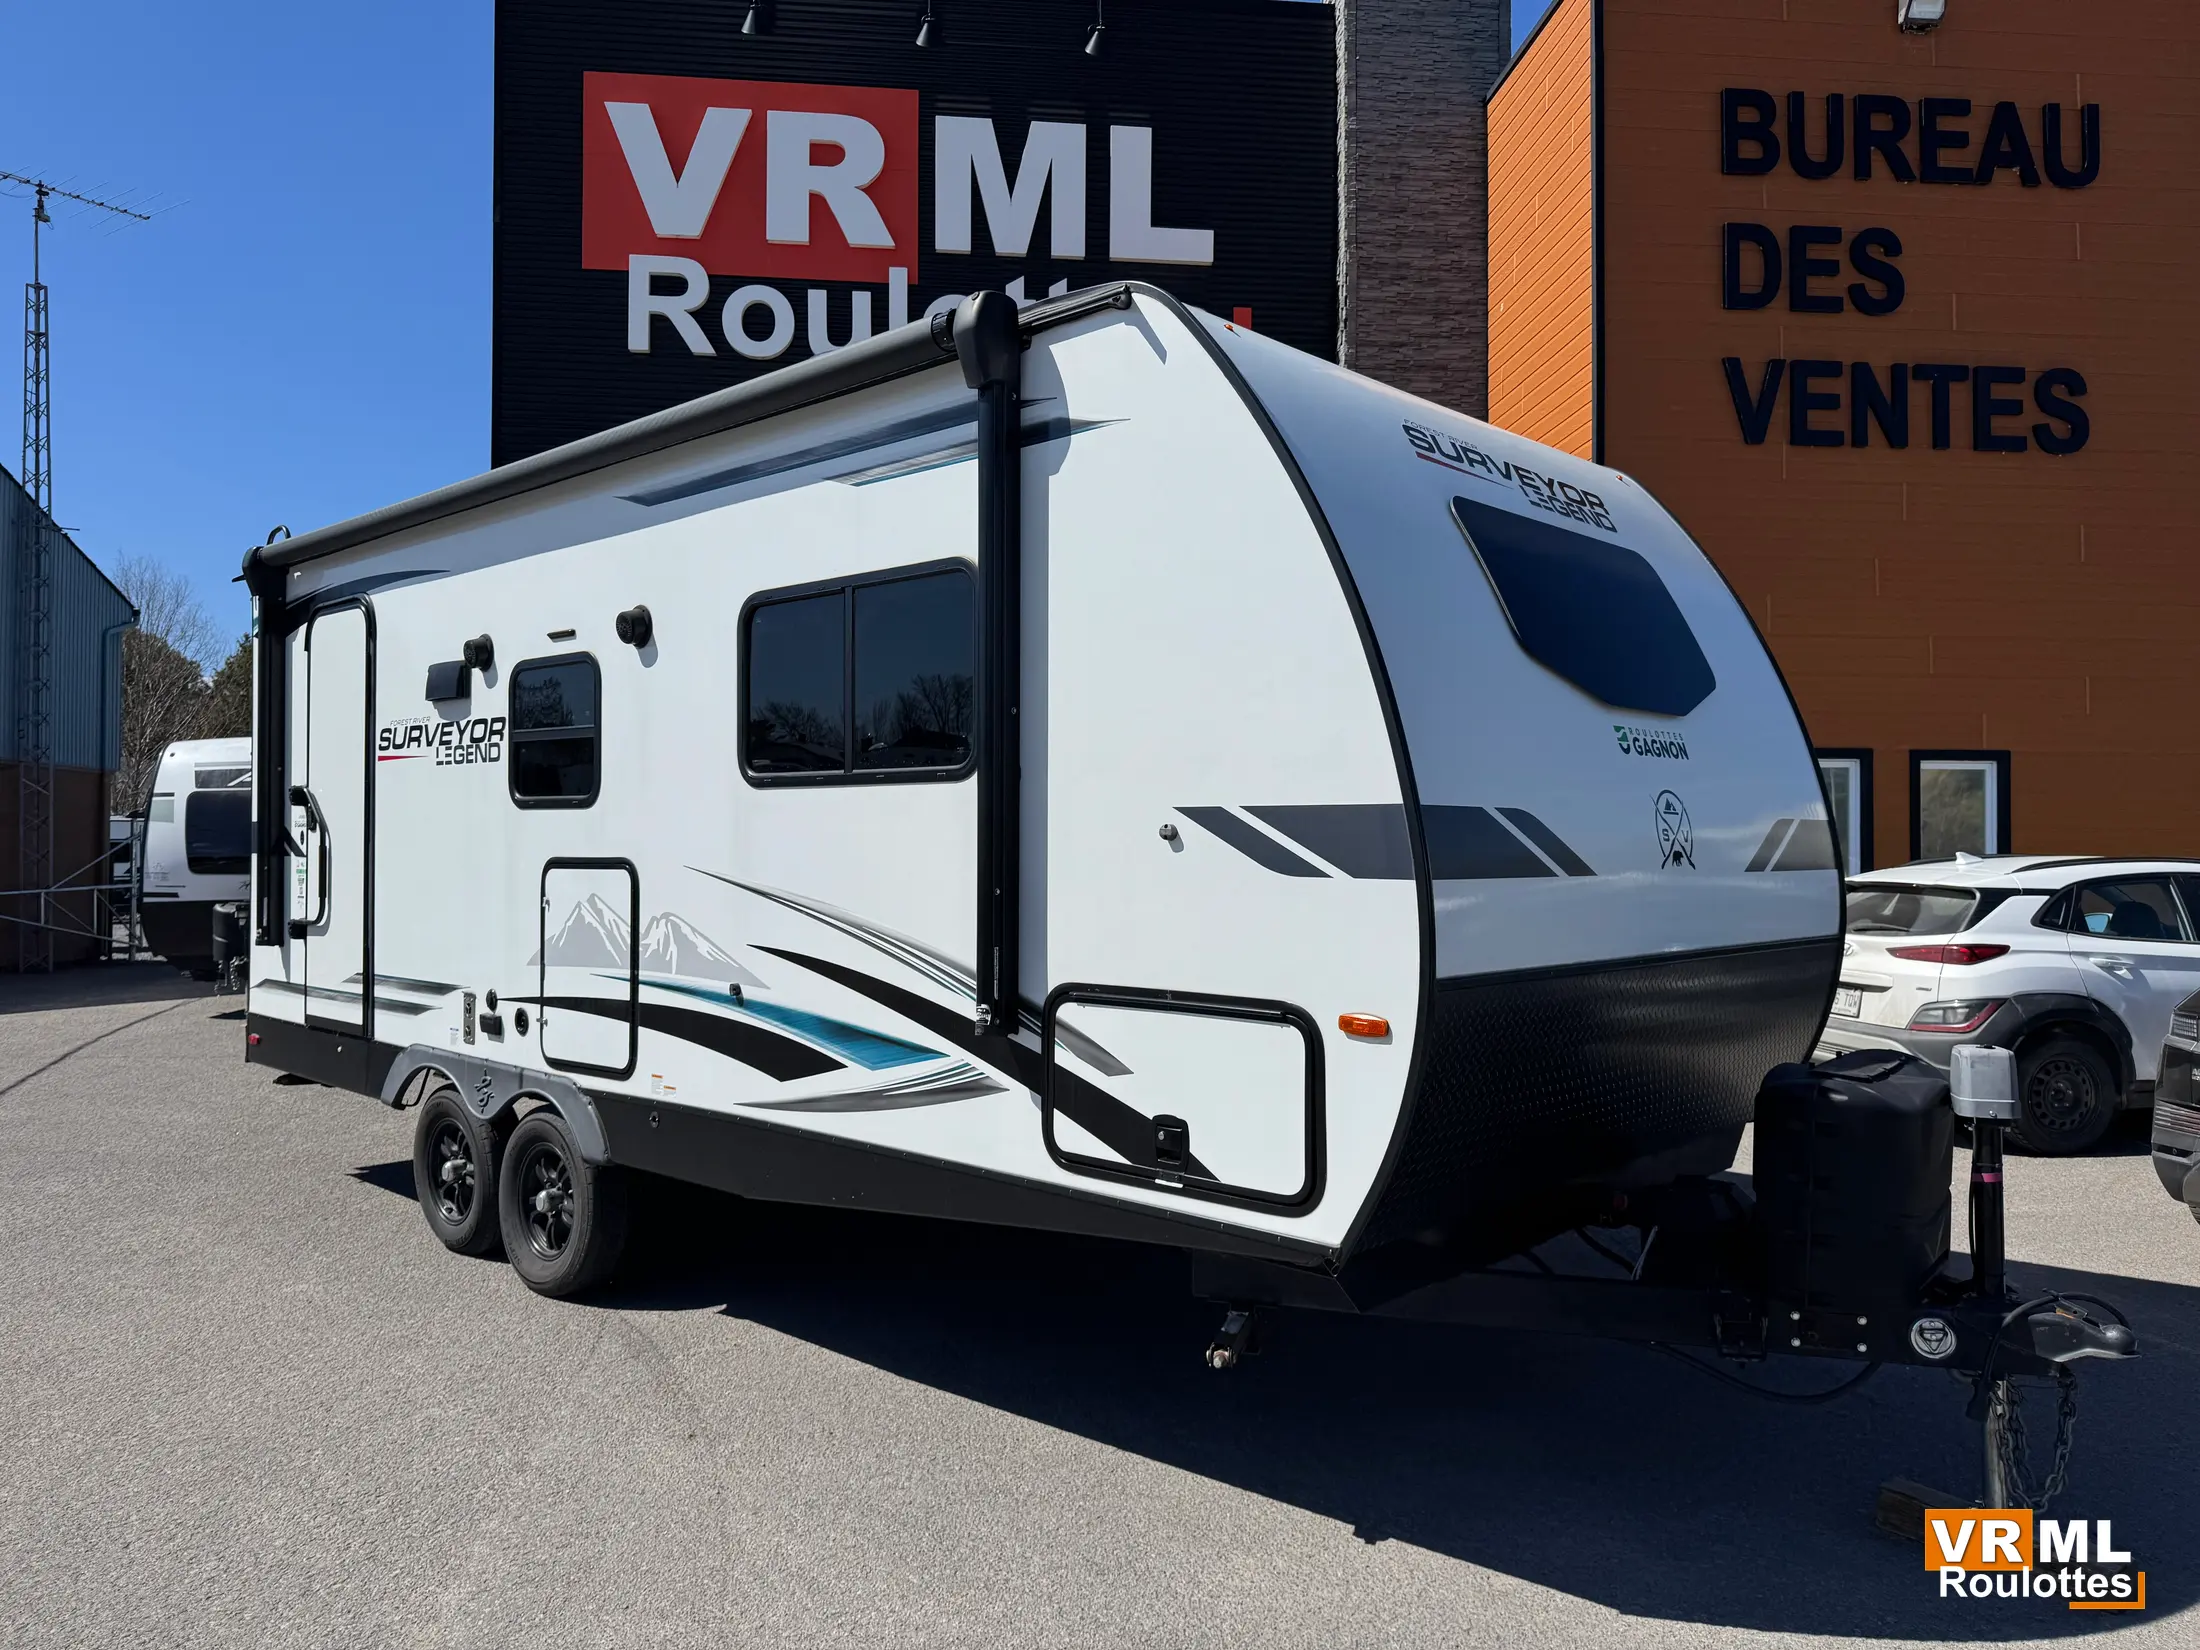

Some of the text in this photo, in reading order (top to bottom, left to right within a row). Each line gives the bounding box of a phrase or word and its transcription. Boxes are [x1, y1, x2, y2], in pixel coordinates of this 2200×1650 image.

[1720, 87, 2100, 189] BUREAU
[1722, 222, 1906, 316] DES
[1721, 356, 2090, 457] VENTES
[1403, 418, 1479, 450] FOREST RIVER
[1402, 424, 1611, 516] SURVEYOR
[1518, 484, 1618, 533] LEGEND
[378, 716, 507, 752] SURVEYOR
[390, 716, 431, 727] FOREST RIVER
[1628, 727, 1685, 741] ROULOTTES
[436, 742, 501, 766] LEGEND
[1632, 736, 1689, 760] GAGNON
